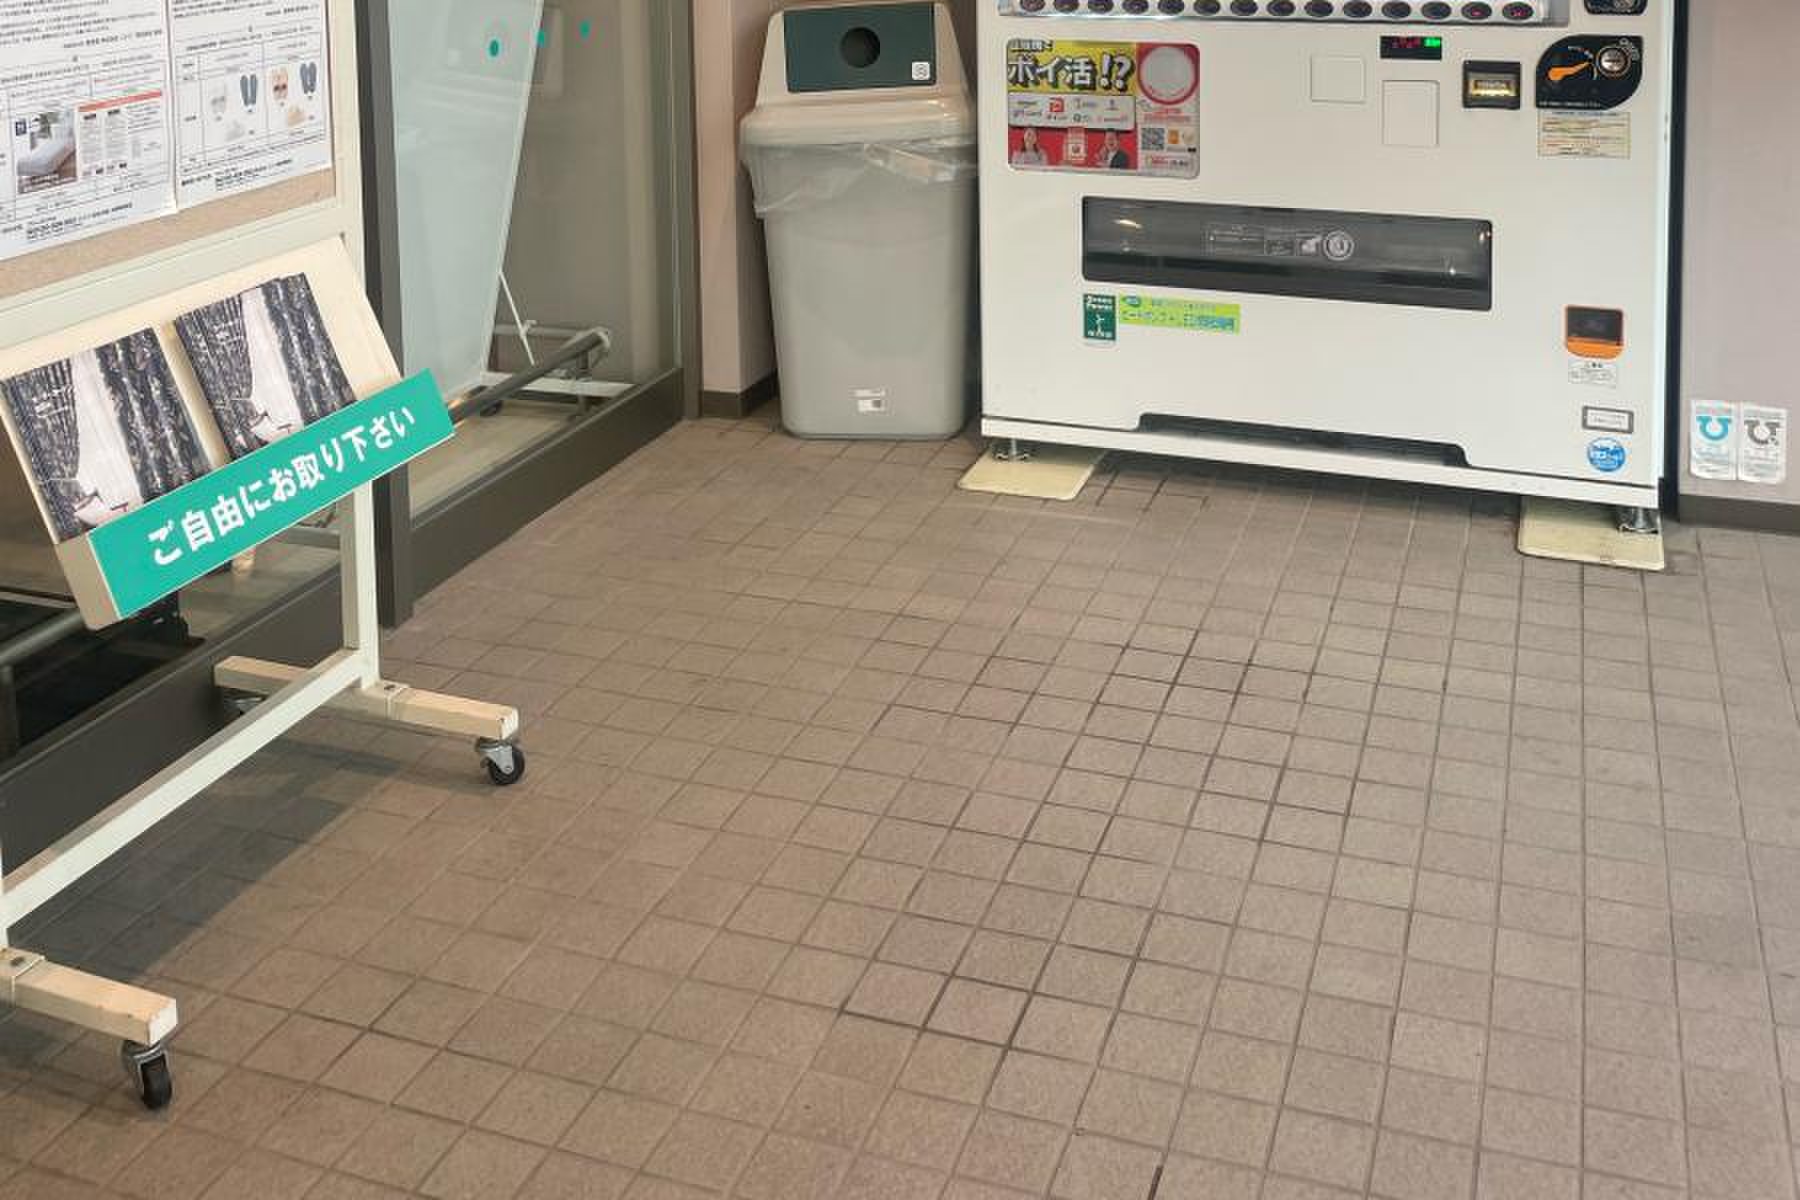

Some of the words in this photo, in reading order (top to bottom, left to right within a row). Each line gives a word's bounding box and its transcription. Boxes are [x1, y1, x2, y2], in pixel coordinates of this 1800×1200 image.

[148, 407, 416, 566] ご自由にお取り下さい
